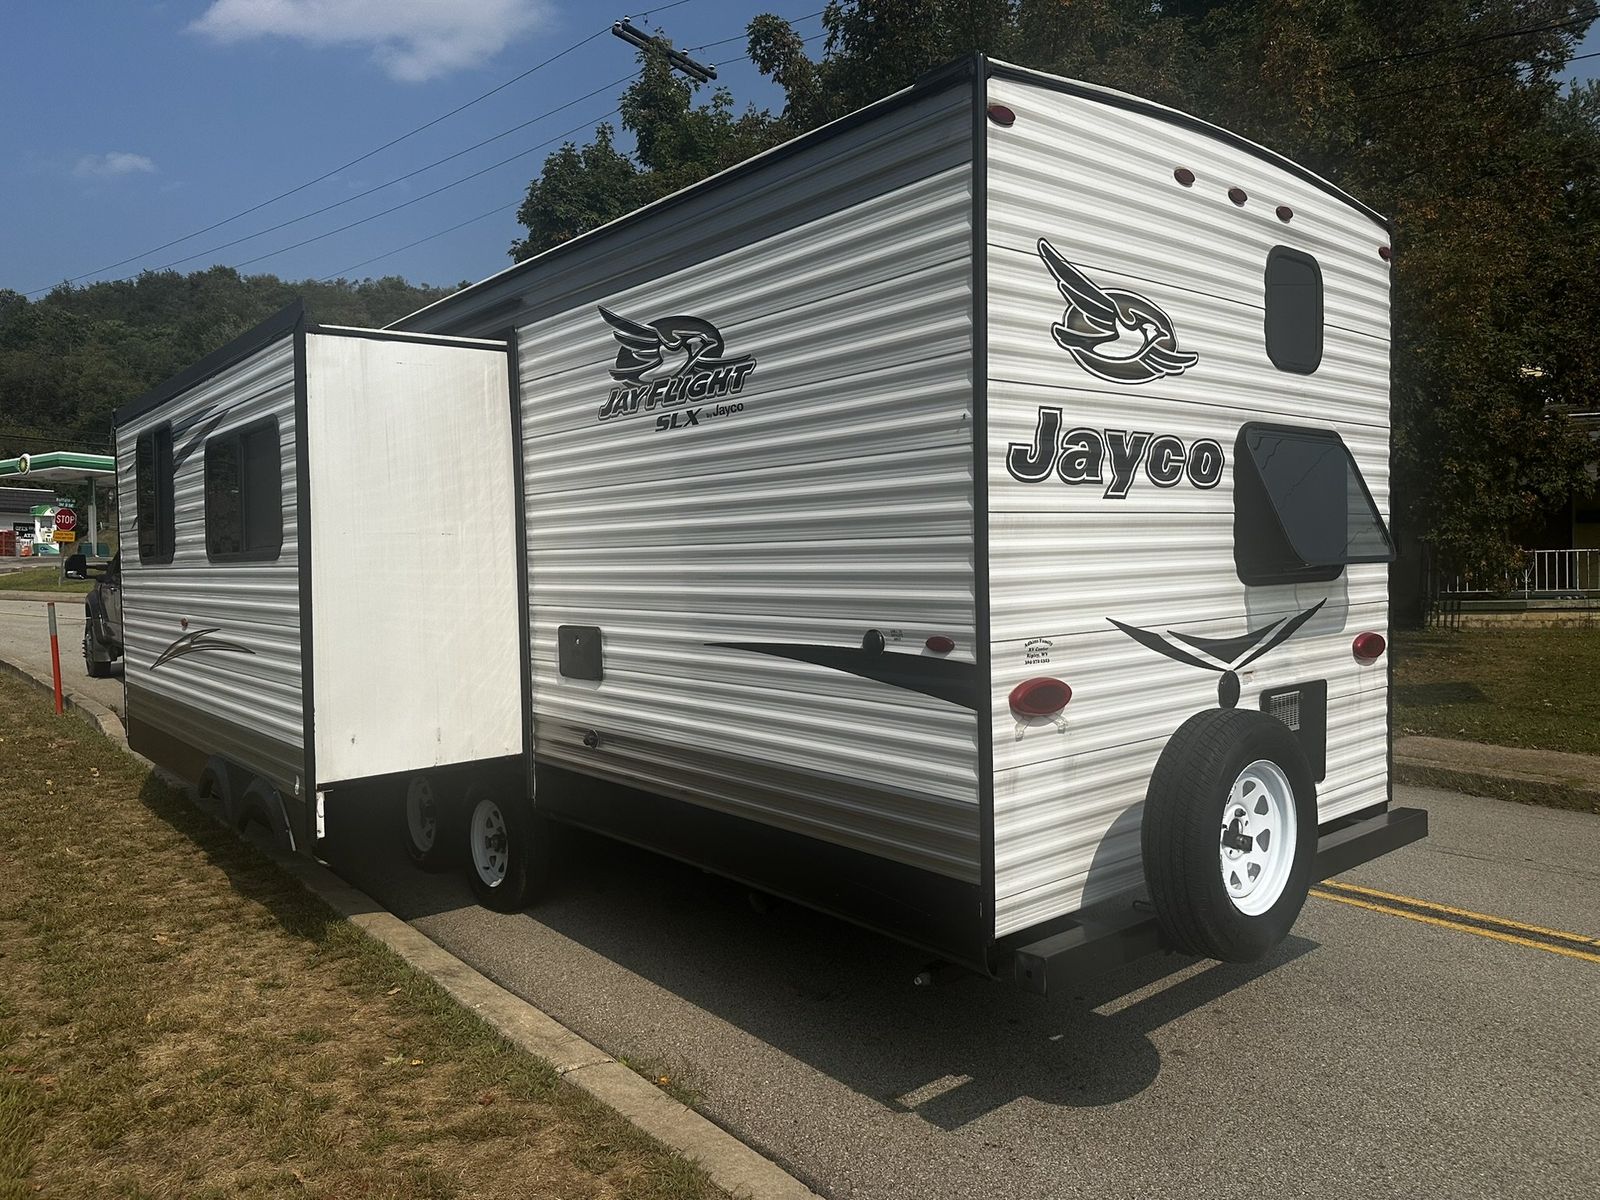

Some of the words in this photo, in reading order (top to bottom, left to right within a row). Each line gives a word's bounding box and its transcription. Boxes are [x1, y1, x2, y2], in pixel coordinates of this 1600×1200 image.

[655, 407, 703, 432] SLX
[713, 403, 744, 417] Jayco
[1006, 406, 1225, 499] Jayco
[56, 515, 75, 524] STOP
